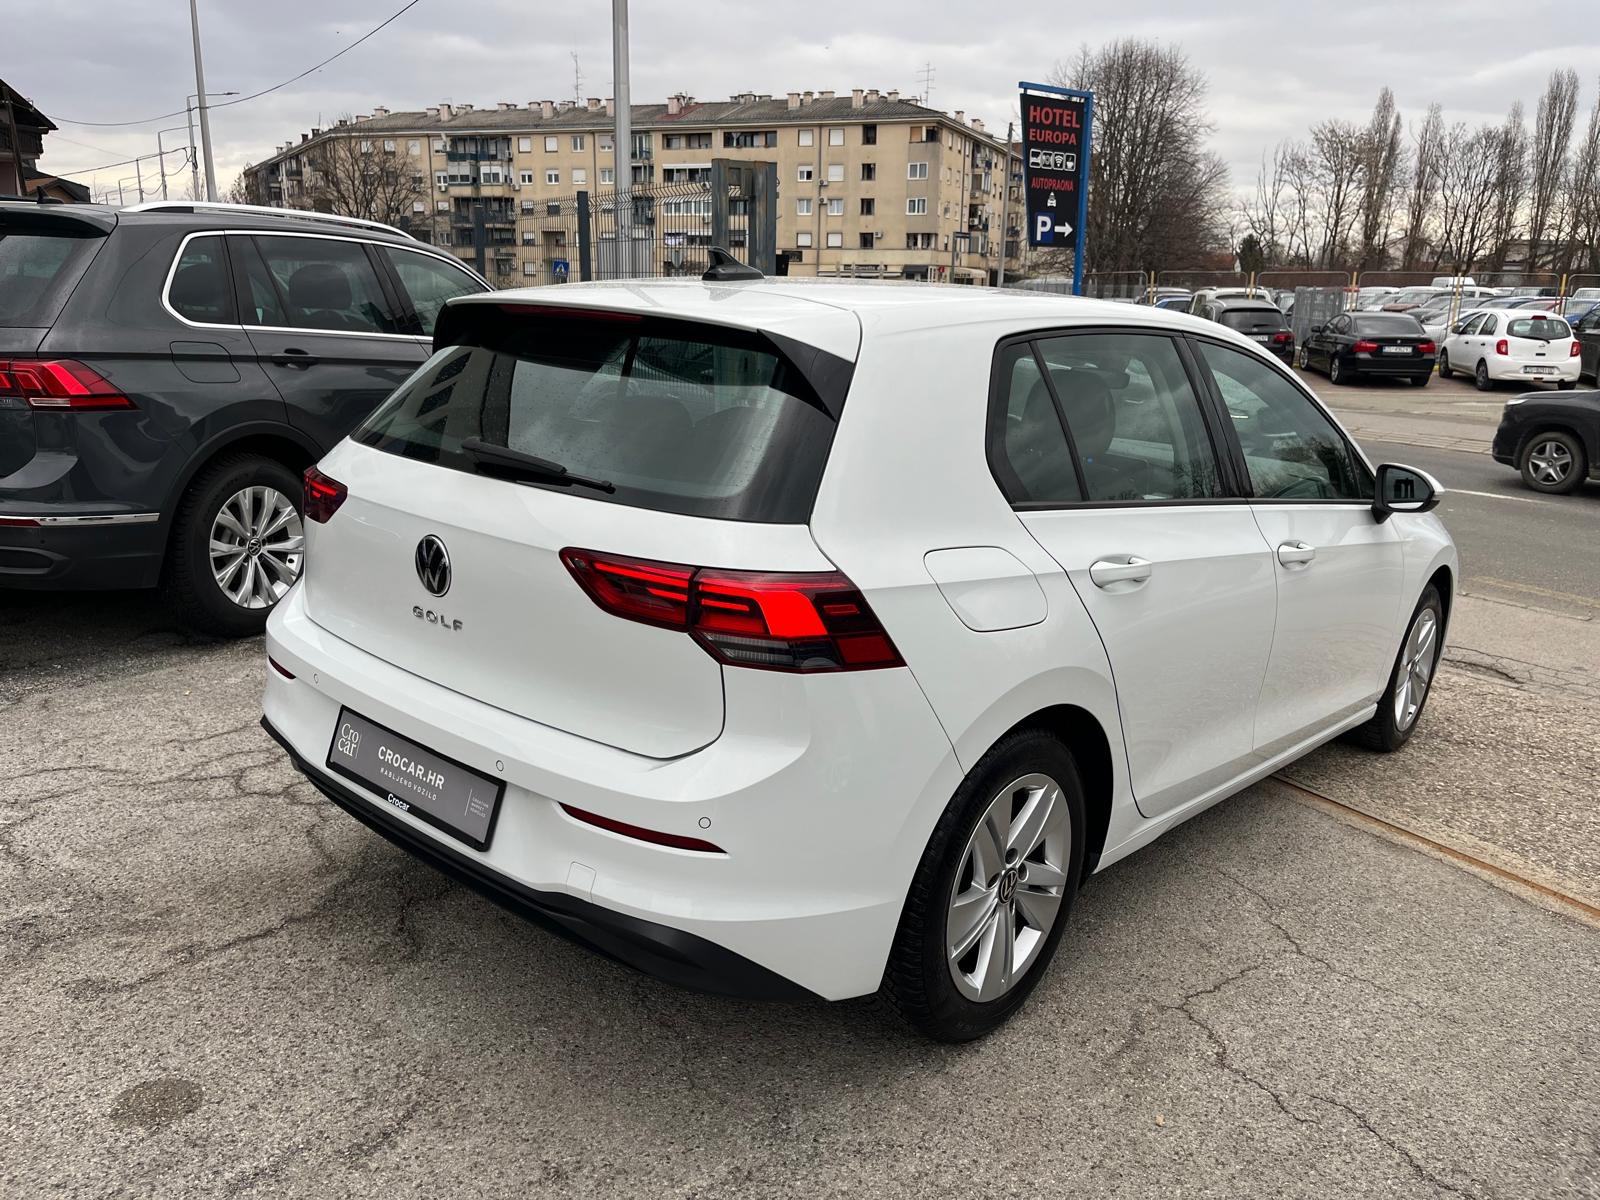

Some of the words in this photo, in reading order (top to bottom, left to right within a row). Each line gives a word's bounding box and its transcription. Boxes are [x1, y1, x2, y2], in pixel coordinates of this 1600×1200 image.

[1029, 105, 1080, 129] HOTEL
[1029, 128, 1077, 145] EUROPA
[1036, 215, 1052, 241] P
[416, 535, 451, 596] VW
[412, 605, 463, 631] GOLF
[341, 723, 359, 743] Cro
[337, 737, 357, 757] car
[378, 745, 445, 790] CROCAR.HR
[387, 793, 410, 811] Crocar
